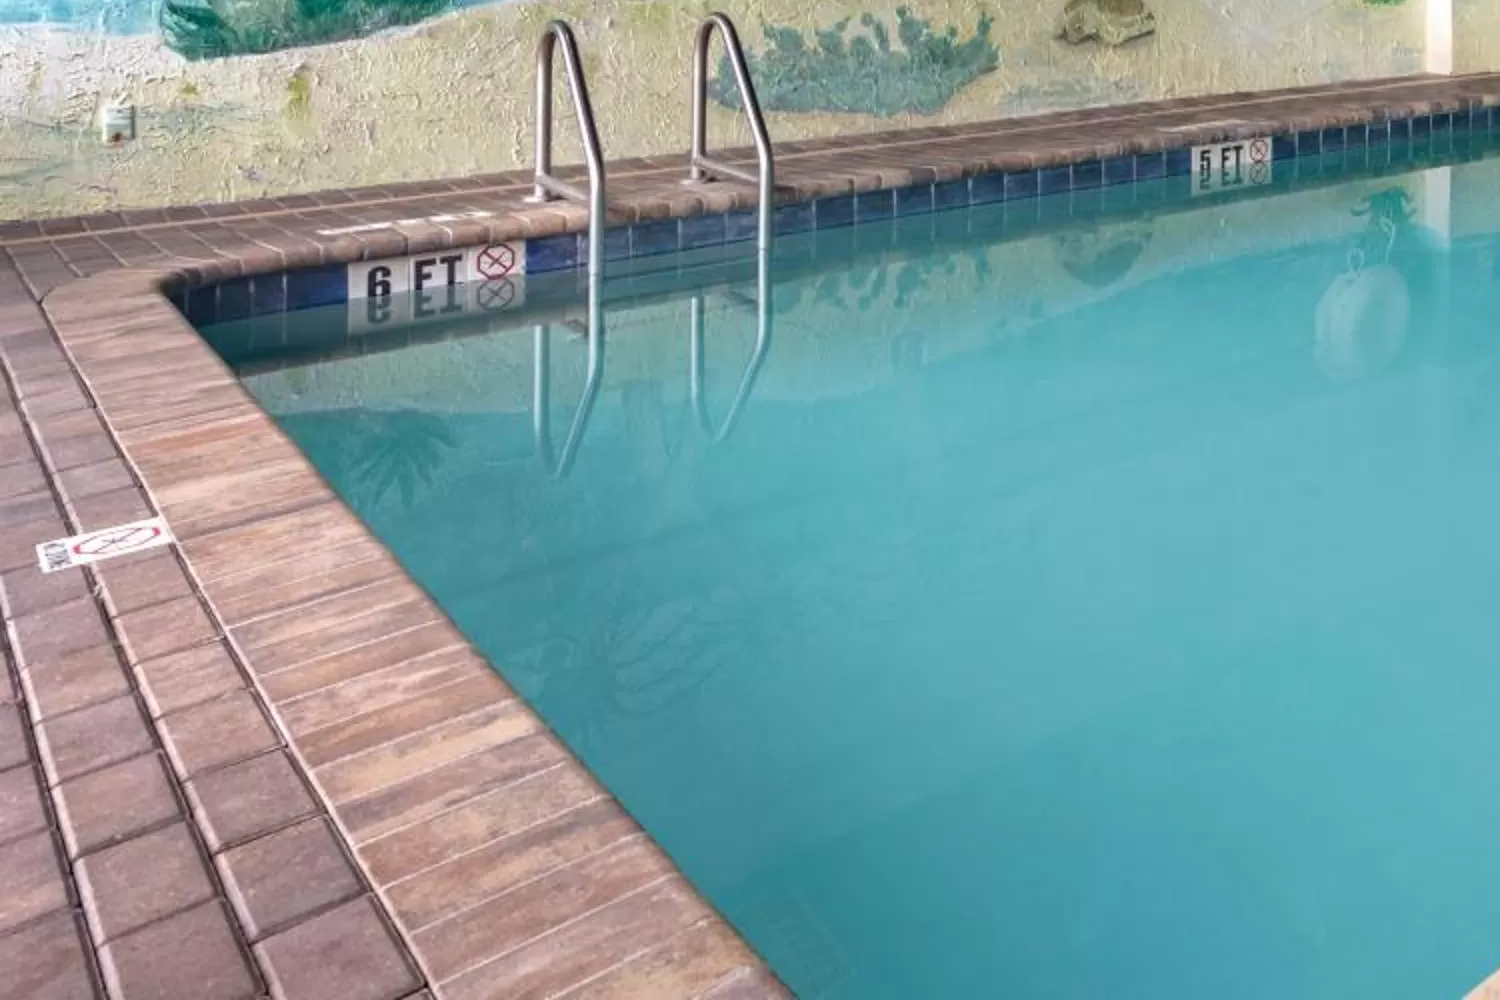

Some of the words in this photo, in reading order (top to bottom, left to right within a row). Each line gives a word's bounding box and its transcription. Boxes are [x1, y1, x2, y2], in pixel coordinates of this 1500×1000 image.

[1200, 150, 1211, 170] 5
[1222, 145, 1243, 168] FT
[367, 266, 392, 298] 6
